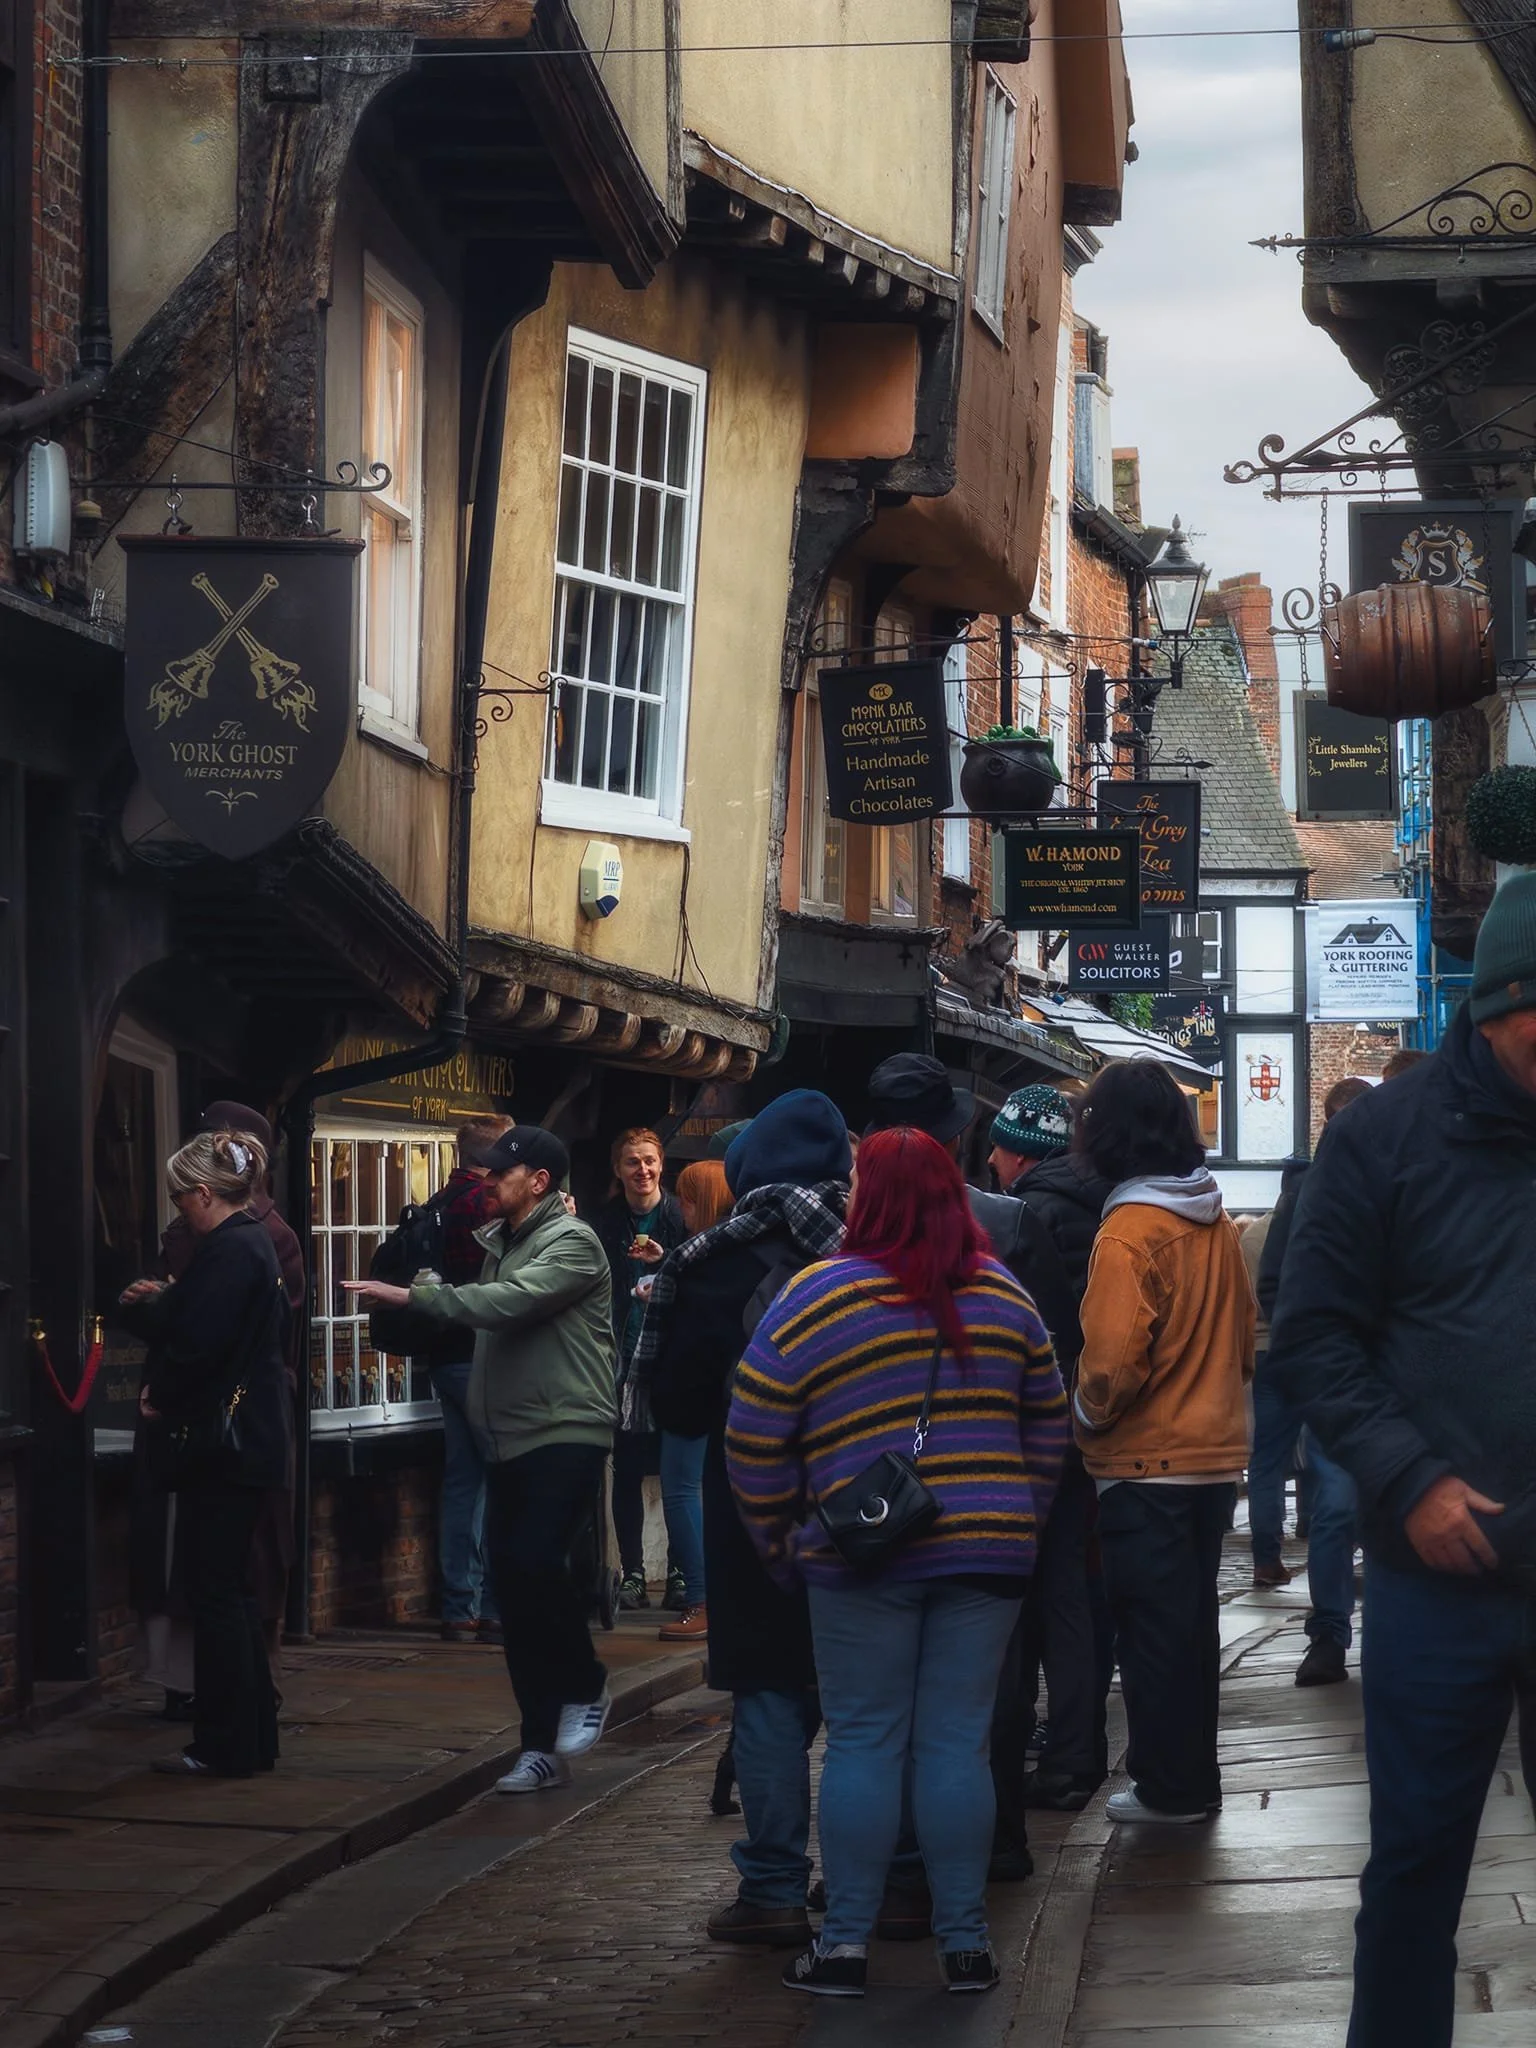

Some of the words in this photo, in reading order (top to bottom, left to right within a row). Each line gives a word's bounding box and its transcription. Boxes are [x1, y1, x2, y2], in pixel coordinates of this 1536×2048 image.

[1428, 551, 1447, 577] S
[851, 704, 886, 720] MONK
[890, 701, 913, 716] BAR
[212, 720, 247, 740] The
[841, 717, 927, 738] CHOCOLATIERS
[170, 742, 224, 763] YORK
[230, 745, 298, 764] GHOST
[1315, 745, 1338, 755] Little
[1340, 744, 1381, 755] Shambles
[847, 750, 930, 771] Handmade
[1329, 758, 1368, 770] Jewellers
[184, 767, 283, 780] MERCHANTS
[864, 775, 916, 791] Artisan
[850, 795, 933, 814] Chocolates
[1136, 793, 1160, 809] The
[1145, 815, 1186, 842] Grey
[1025, 845, 1044, 862] W.
[1047, 847, 1121, 862] HAMOND
[1140, 844, 1171, 872] Tea
[1062, 863, 1085, 872] YORK
[1029, 903, 1117, 913] www.whamond.com
[1114, 943, 1151, 951] GUEST
[1114, 953, 1160, 961] WALKER
[1323, 951, 1356, 961] YORK
[1359, 950, 1413, 961] ROOFING
[1079, 967, 1161, 979] SOLICITORS
[1329, 963, 1339, 973] &
[1342, 962, 1408, 973] GUTTERING
[412, 1095, 423, 1119] OF
[425, 1097, 447, 1121] YORK
